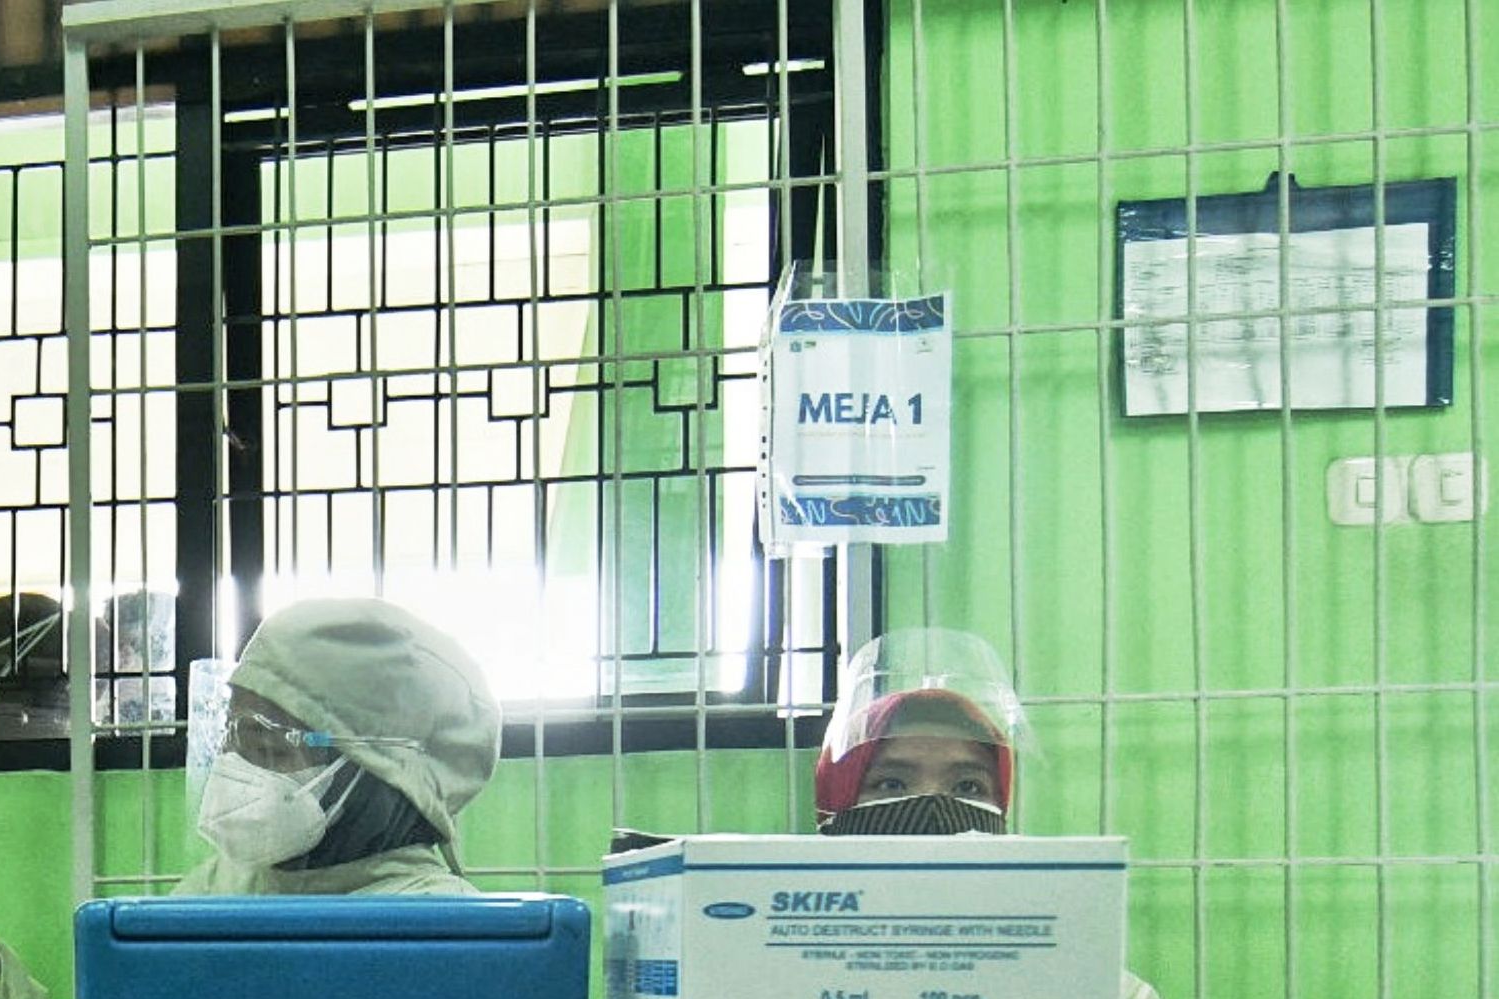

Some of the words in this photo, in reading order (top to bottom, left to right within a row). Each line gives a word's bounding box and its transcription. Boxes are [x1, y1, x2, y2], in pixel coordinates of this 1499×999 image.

[797, 393, 897, 424] MEJA
[908, 393, 922, 424] 1
[771, 891, 859, 912] SKIFA
[771, 925, 808, 936] AUTO
[813, 925, 887, 936] DESTRUCT
[996, 925, 1052, 936] NEEDLE
